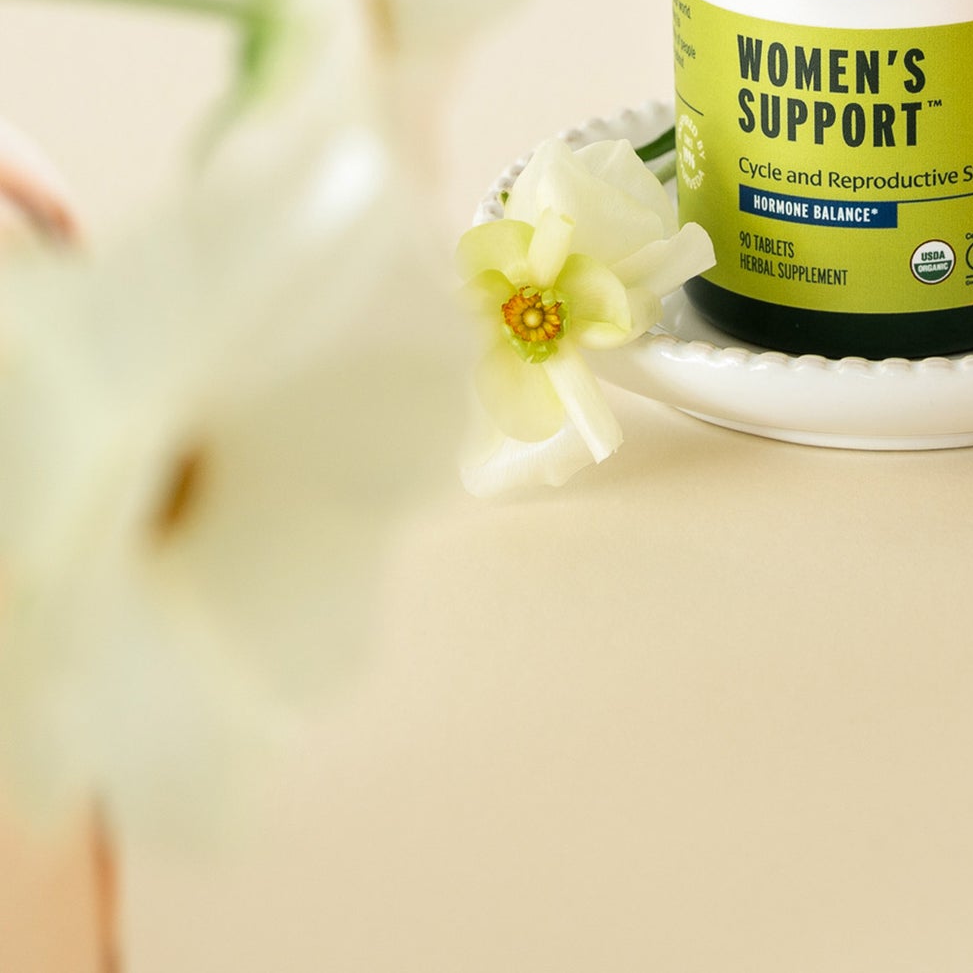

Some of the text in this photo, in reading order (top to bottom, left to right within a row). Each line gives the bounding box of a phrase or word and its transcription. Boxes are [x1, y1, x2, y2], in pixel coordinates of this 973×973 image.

[737, 34, 926, 95] WOMEN'S
[739, 156, 783, 181] Cycle
[786, 169, 823, 188] and
[828, 169, 958, 192] Reproductive
[753, 194, 809, 219] HORMONE
[739, 230, 795, 259] 90 TABLETS
[921, 250, 946, 261] USDA
[740, 252, 848, 286] HERBAL SUPPLEMENT
[917, 262, 949, 273] ORGANIC
